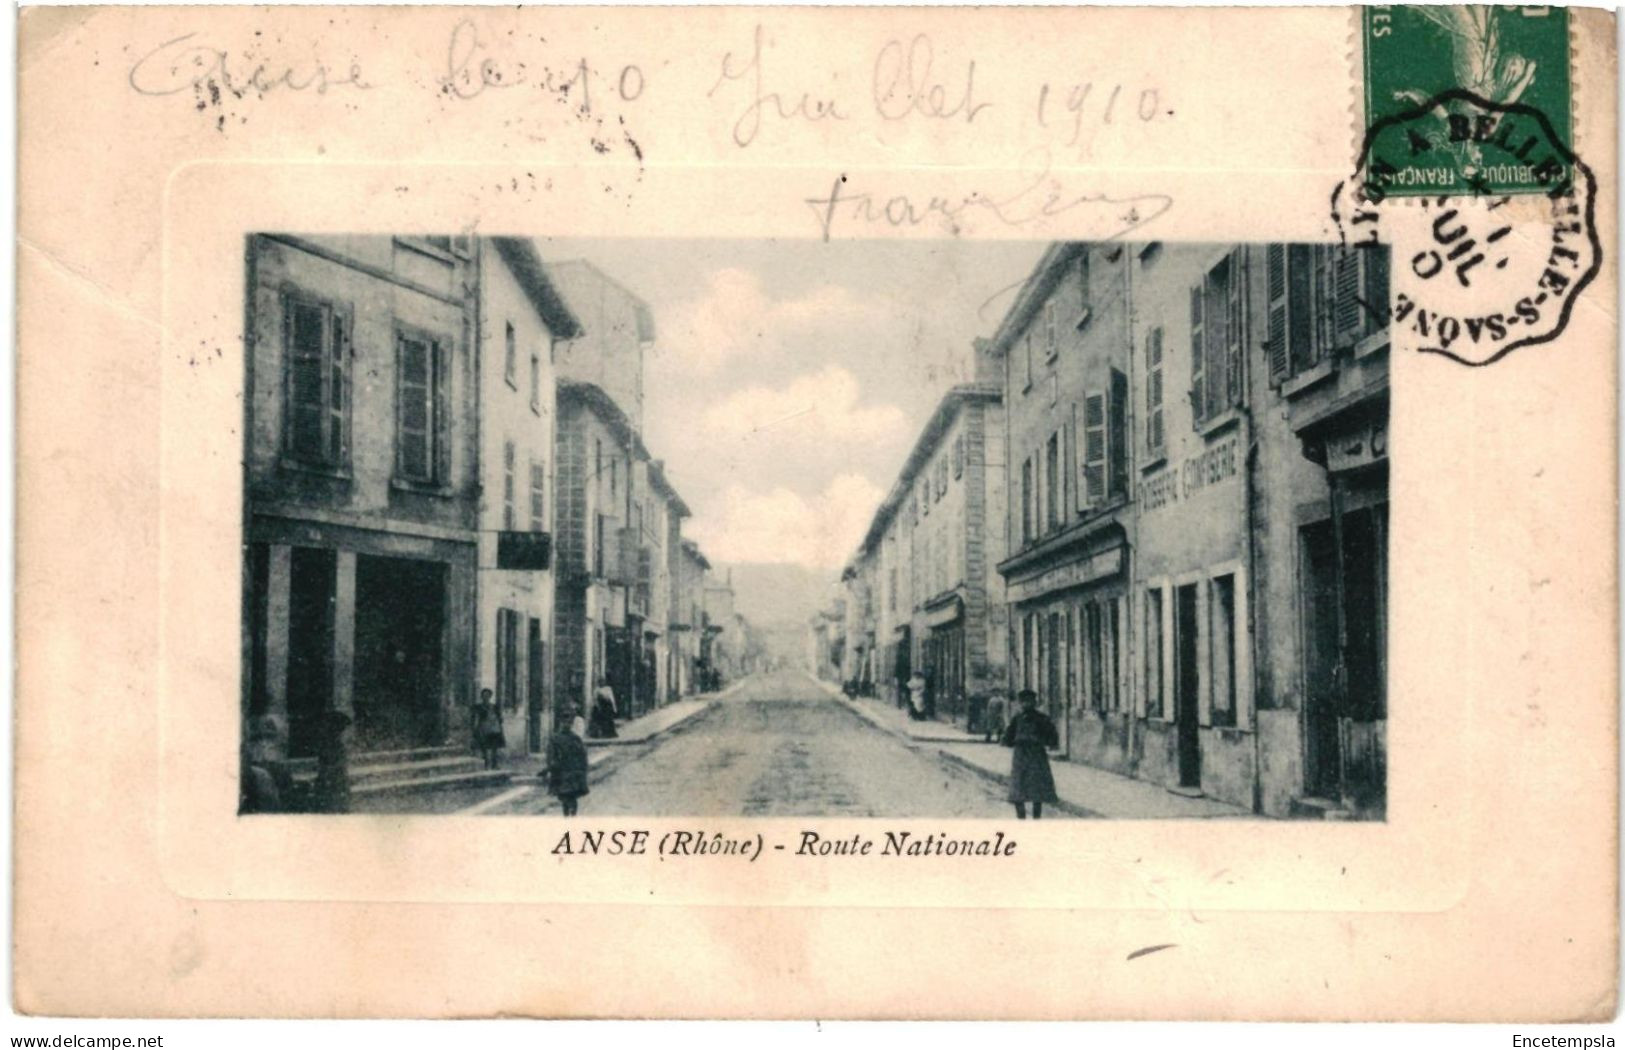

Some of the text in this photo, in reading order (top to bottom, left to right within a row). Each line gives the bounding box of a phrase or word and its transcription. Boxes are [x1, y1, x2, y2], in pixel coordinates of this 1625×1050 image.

[1374, 163, 1568, 186] RUBLIQUE FRANÇAI
[551, 830, 649, 856] ANSE
[658, 830, 763, 862] (Rhône)
[795, 831, 873, 857] Route
[881, 831, 1017, 857] Nationale
